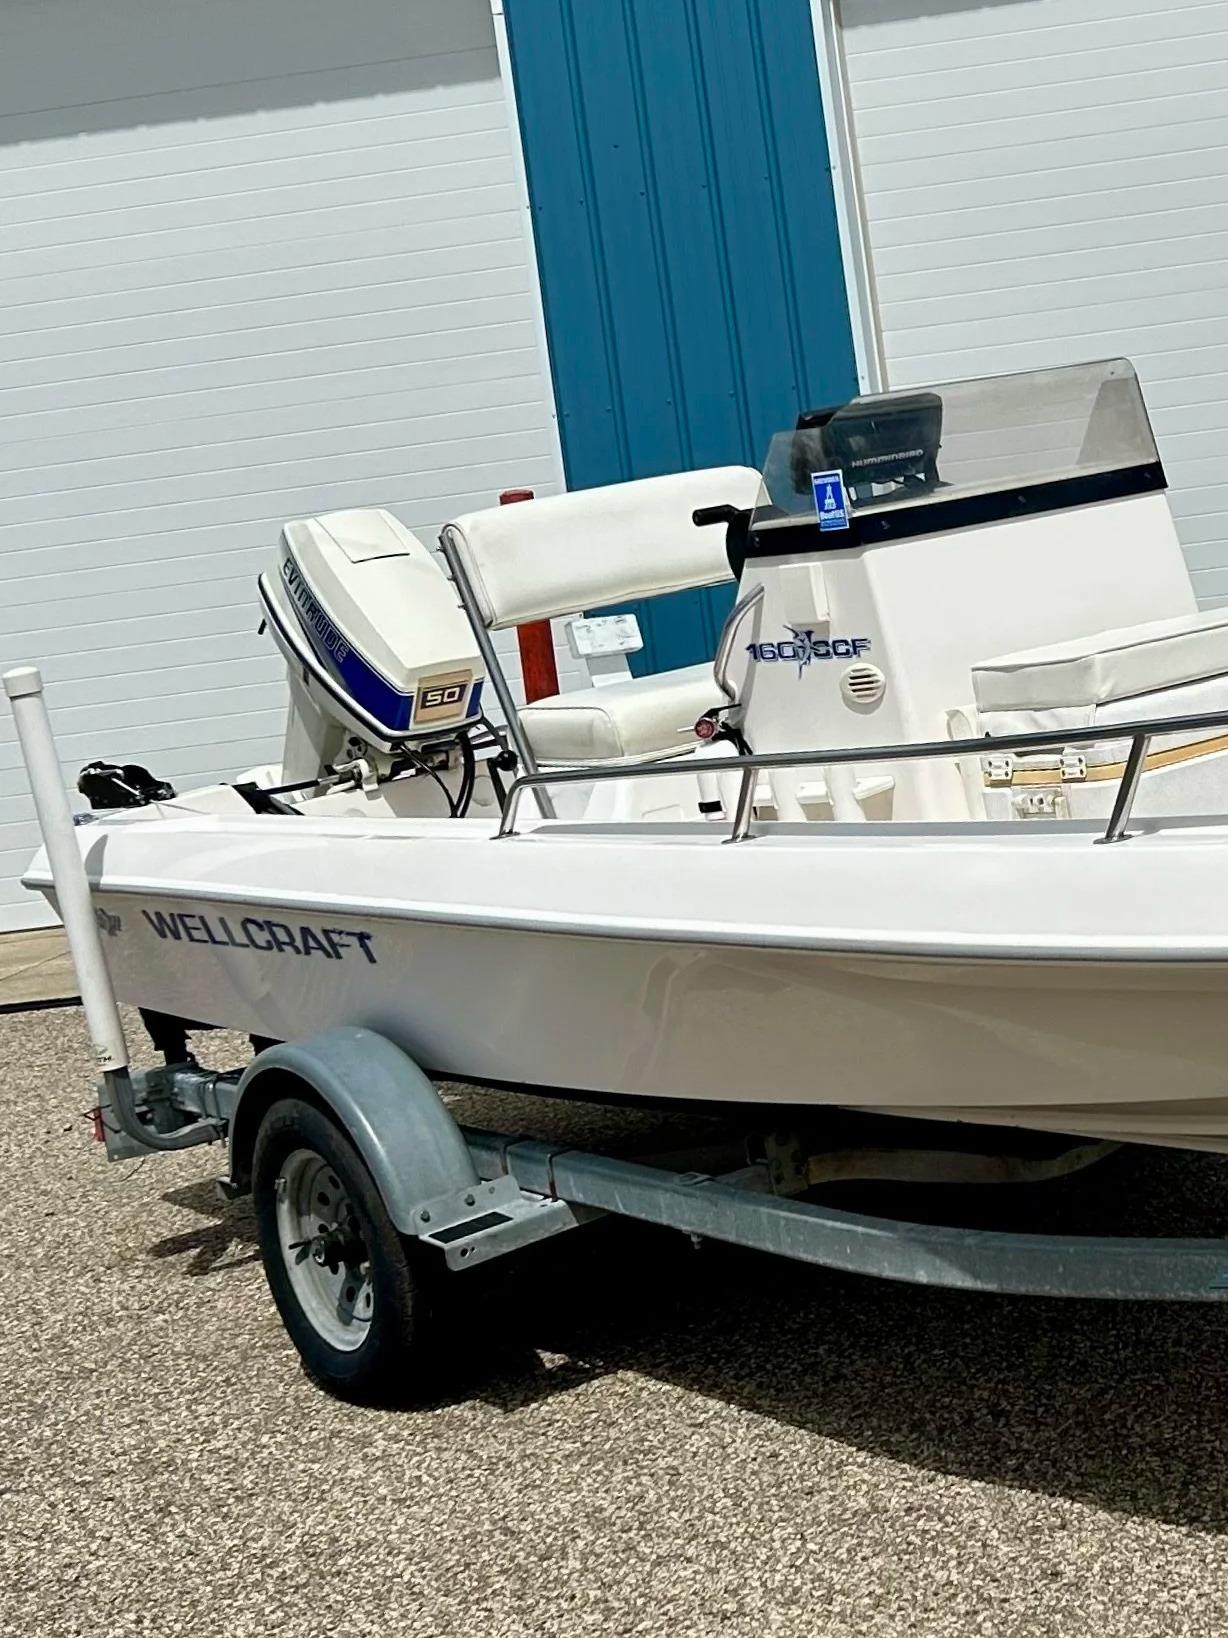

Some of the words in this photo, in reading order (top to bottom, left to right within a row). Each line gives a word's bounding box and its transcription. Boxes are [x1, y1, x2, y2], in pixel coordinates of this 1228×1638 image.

[283, 556, 350, 664] EVINRUDE
[745, 640, 799, 663] 160
[425, 686, 460, 707] 50
[141, 909, 378, 965] WELLCRAFT
